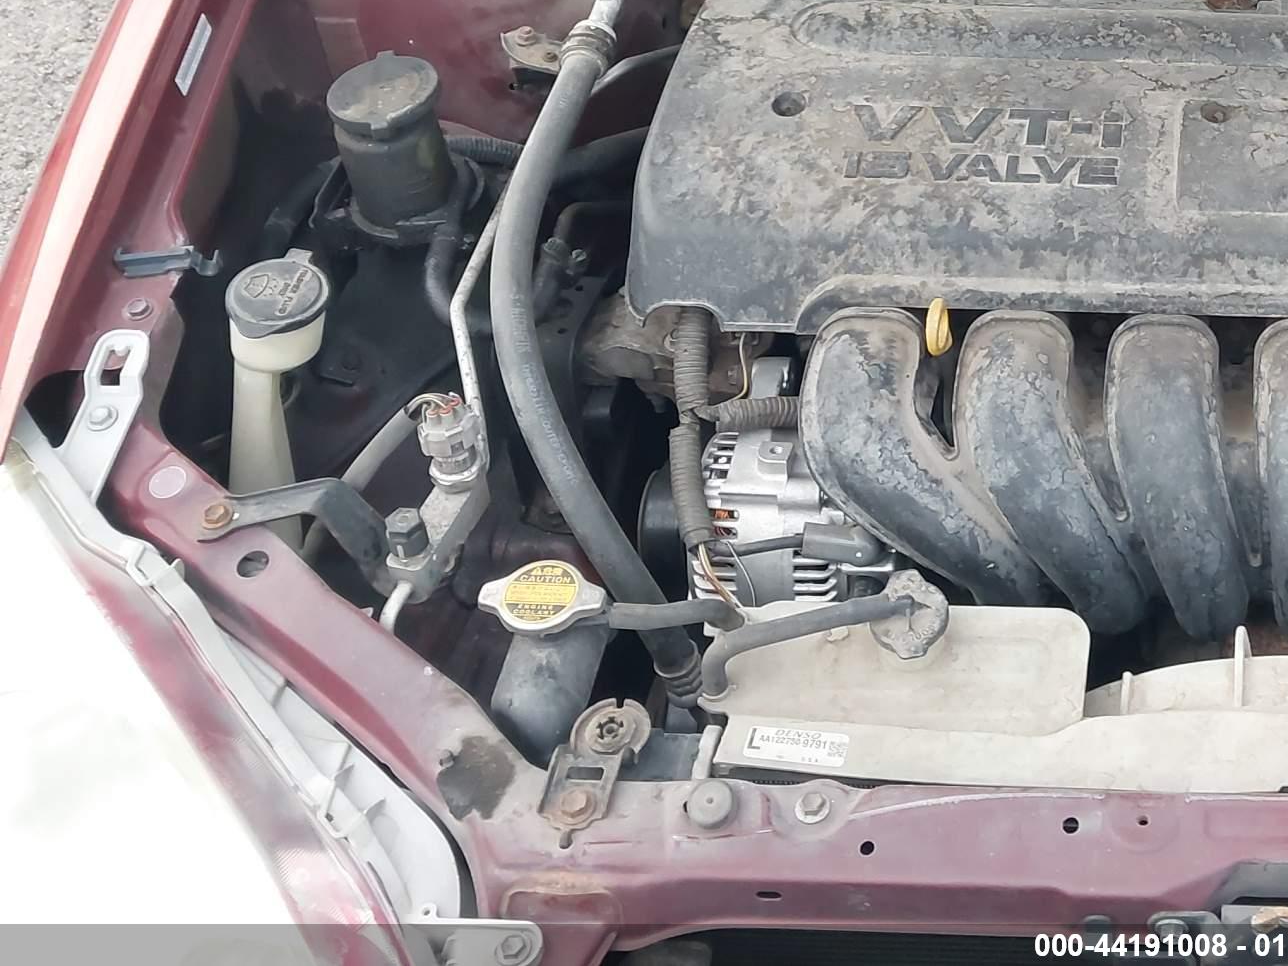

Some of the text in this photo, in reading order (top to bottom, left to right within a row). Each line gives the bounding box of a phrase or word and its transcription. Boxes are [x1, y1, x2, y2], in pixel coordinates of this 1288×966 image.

[853, 105, 1124, 148] VVT-i
[921, 153, 1119, 186] VALVE
[519, 574, 572, 584] CAUTION
[775, 729, 822, 740] DENSO
